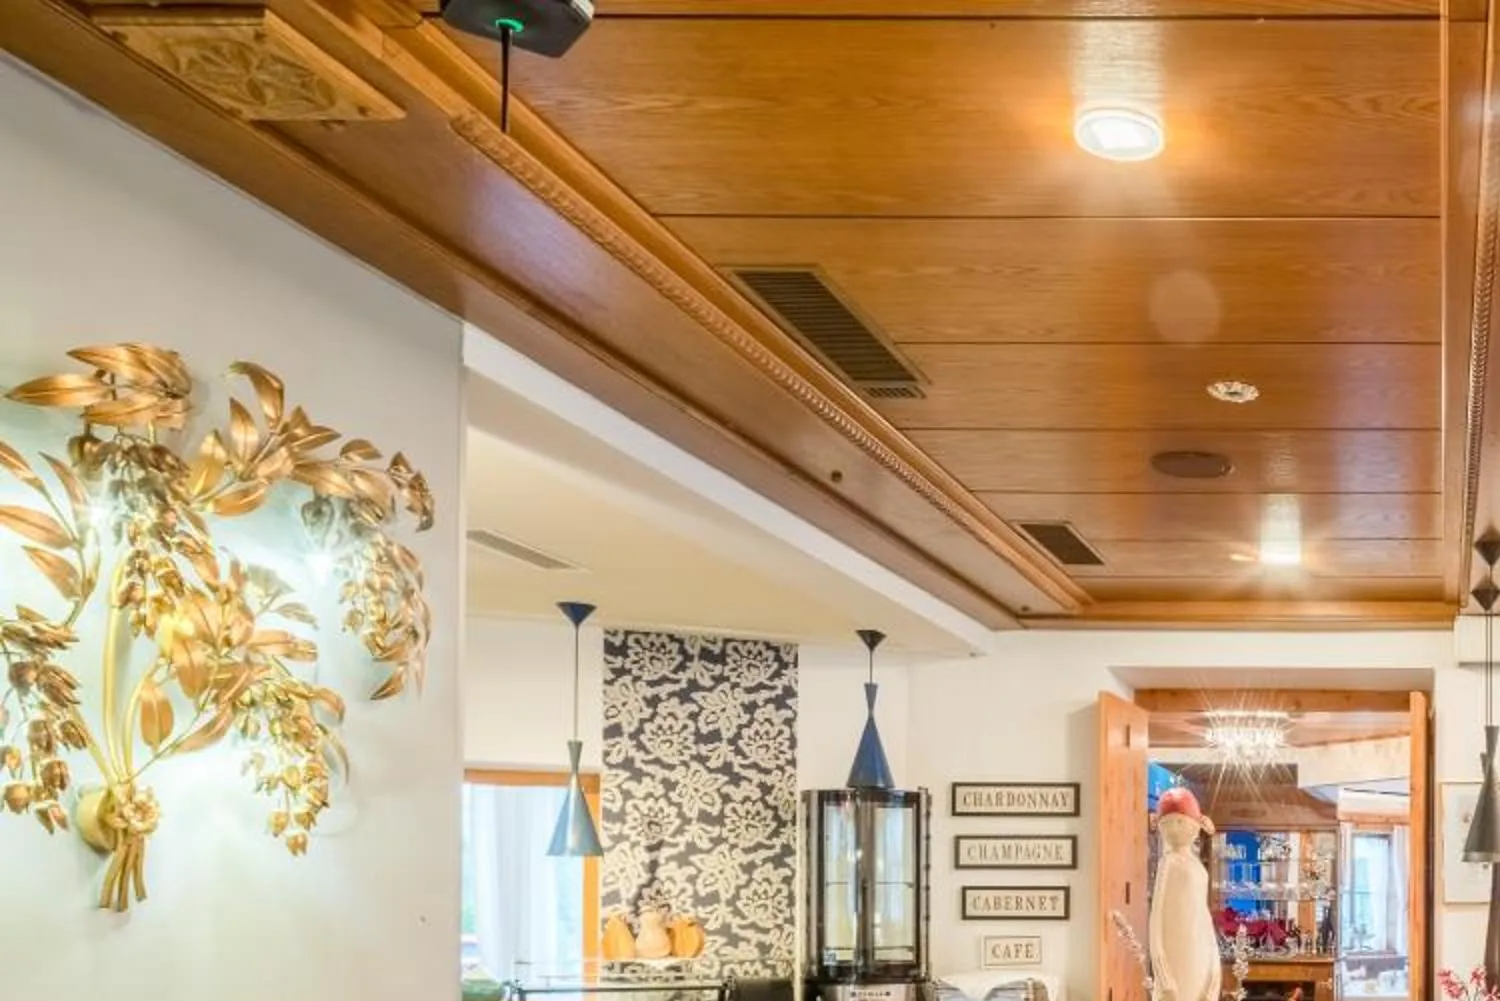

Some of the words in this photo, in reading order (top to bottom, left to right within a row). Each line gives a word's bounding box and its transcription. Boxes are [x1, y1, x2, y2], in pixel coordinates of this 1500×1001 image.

[963, 792, 1069, 808] CHARDONNAY
[967, 845, 1063, 861] CHAMPAGNE
[973, 895, 1058, 911] CABERNET
[991, 943, 1034, 959] CAFE
